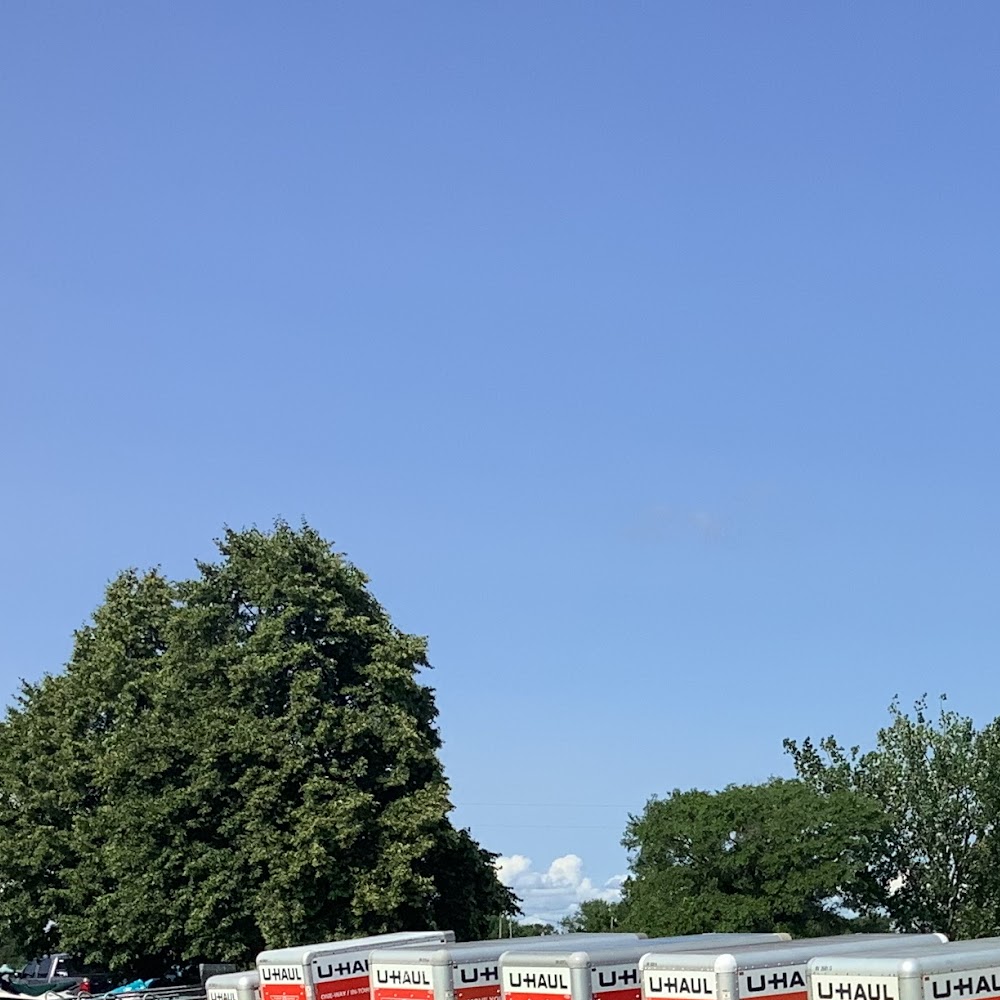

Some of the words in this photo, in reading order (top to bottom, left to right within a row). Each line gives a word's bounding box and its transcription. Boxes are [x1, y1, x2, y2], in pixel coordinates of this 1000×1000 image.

[262, 968, 302, 981] U-HAUL
[376, 970, 430, 985] U-HAUL
[509, 973, 568, 989] U-HAUL
[649, 977, 713, 994] U-HAUL
[818, 982, 894, 1000] U-HAUL
